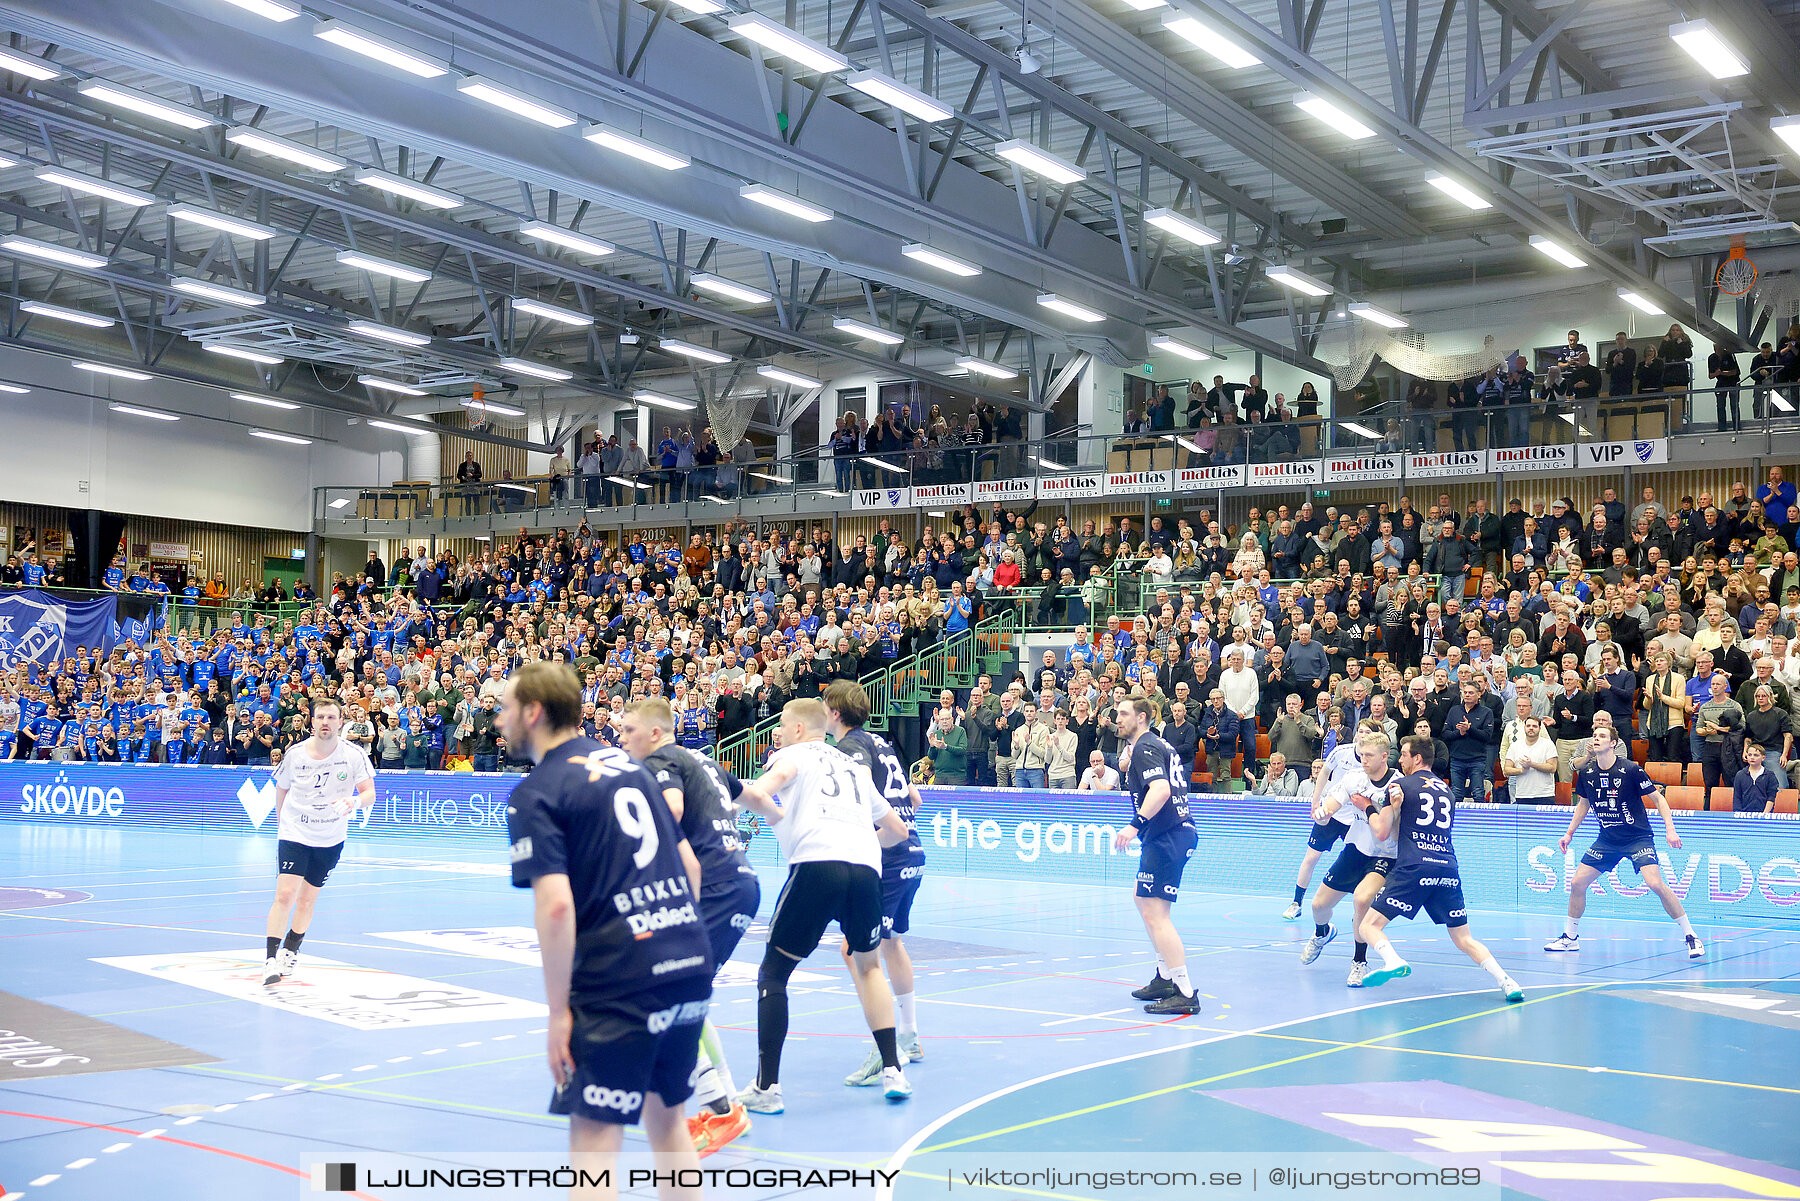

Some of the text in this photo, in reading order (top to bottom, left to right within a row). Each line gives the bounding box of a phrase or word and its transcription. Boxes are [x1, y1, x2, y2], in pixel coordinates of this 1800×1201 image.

[1412, 452, 1478, 467] mattias
[1497, 446, 1566, 461] mattias
[1589, 445, 1623, 462] VIP
[1254, 463, 1315, 476] mattias
[1331, 457, 1394, 472] mattias
[1502, 462, 1560, 472] CATERING
[1110, 471, 1166, 485] mattias
[1181, 466, 1238, 480] mattias
[1336, 472, 1389, 481] CATERING
[1418, 468, 1472, 477] CATERING
[978, 479, 1029, 493] mattias
[1043, 477, 1097, 490] mattias
[1185, 480, 1233, 490] CATERING
[1259, 478, 1310, 486] CATERING
[916, 485, 965, 498] mattias
[1047, 490, 1092, 498] CATERING
[1115, 486, 1161, 494] CATERING
[859, 492, 881, 505] VIP
[641, 529, 666, 540] 2019
[313, 772, 330, 789] 27
[819, 757, 862, 805] 31
[1595, 789, 1601, 798] 7
[385, 790, 402, 823] it
[412, 790, 459, 826] like
[1416, 792, 1452, 829] 33
[614, 786, 659, 870] 9
[931, 809, 1002, 850] the
[1411, 831, 1449, 844] BRIXLY
[282, 861, 295, 870] 27
[1386, 897, 1413, 912] coop
[583, 1084, 643, 1115] coop
